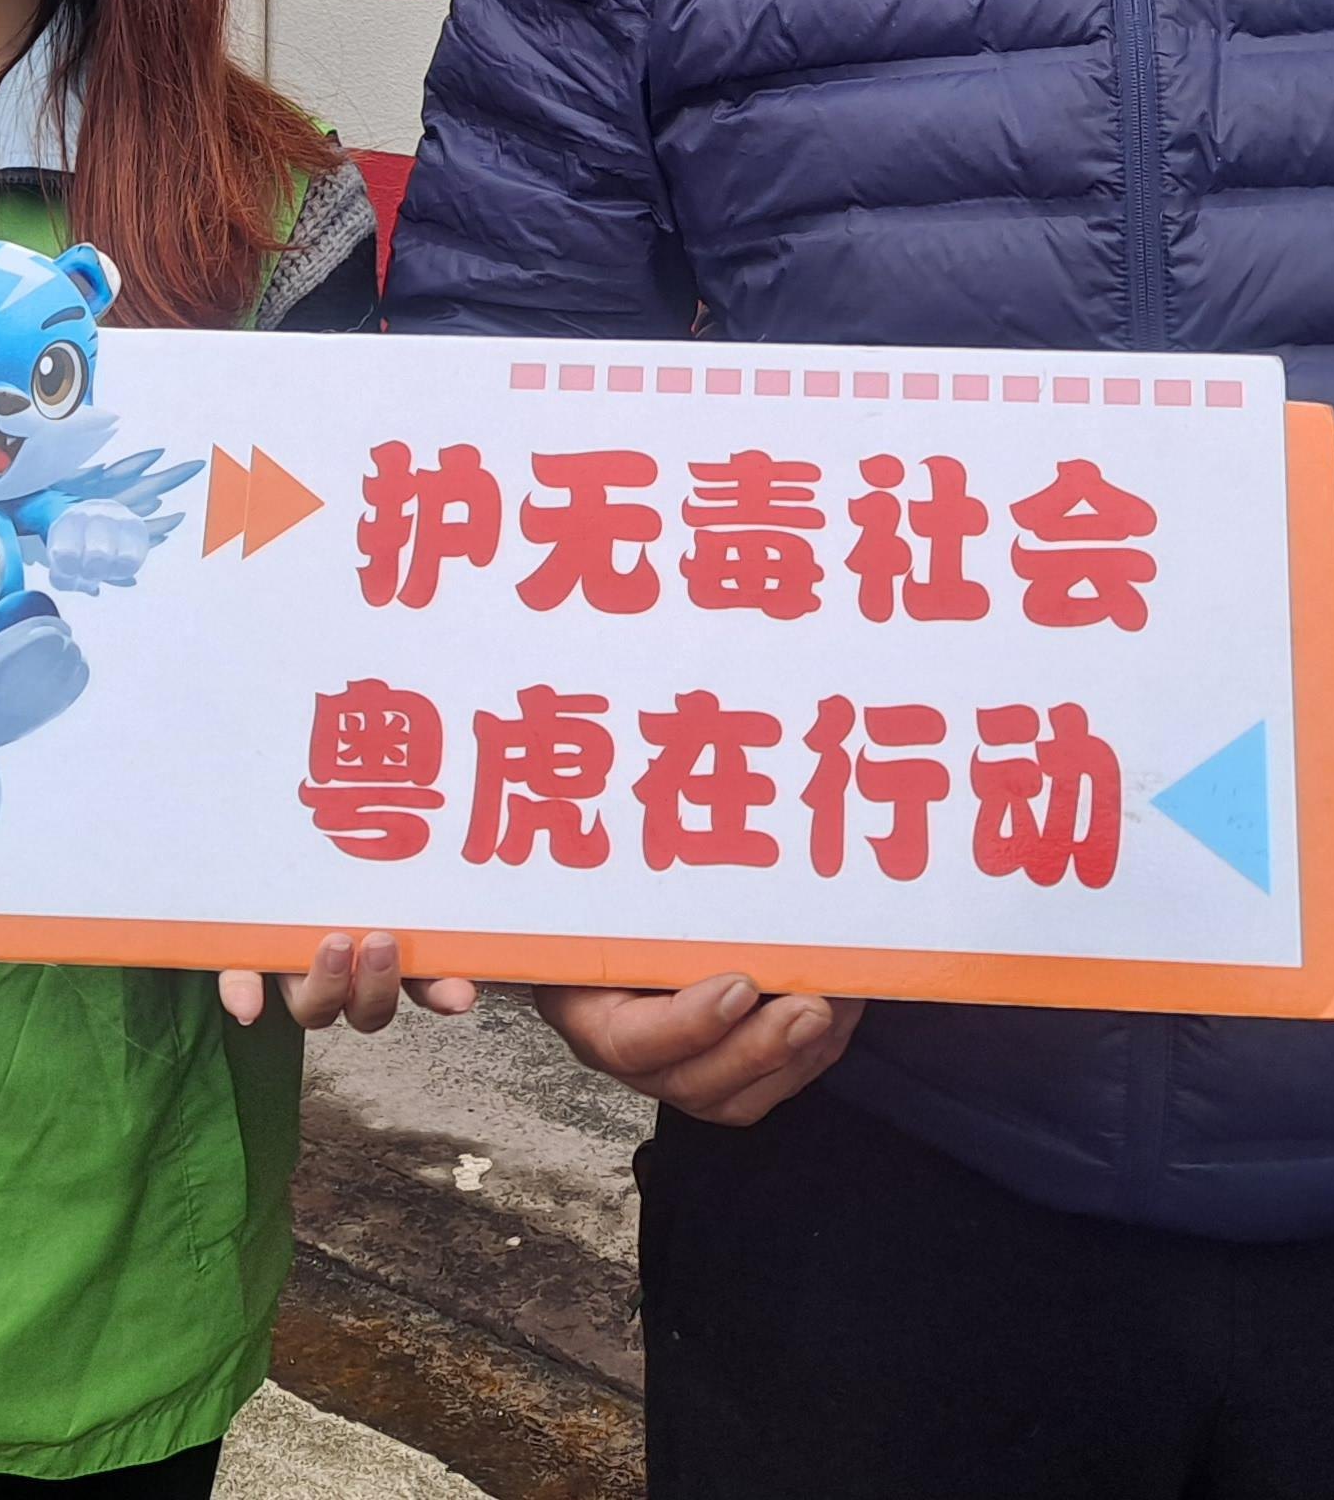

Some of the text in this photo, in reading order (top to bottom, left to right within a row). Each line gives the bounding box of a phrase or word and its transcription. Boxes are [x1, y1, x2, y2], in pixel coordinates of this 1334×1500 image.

[357, 441, 1158, 632] 护无毒社会
[299, 678, 1122, 890] 粤虎在行动
